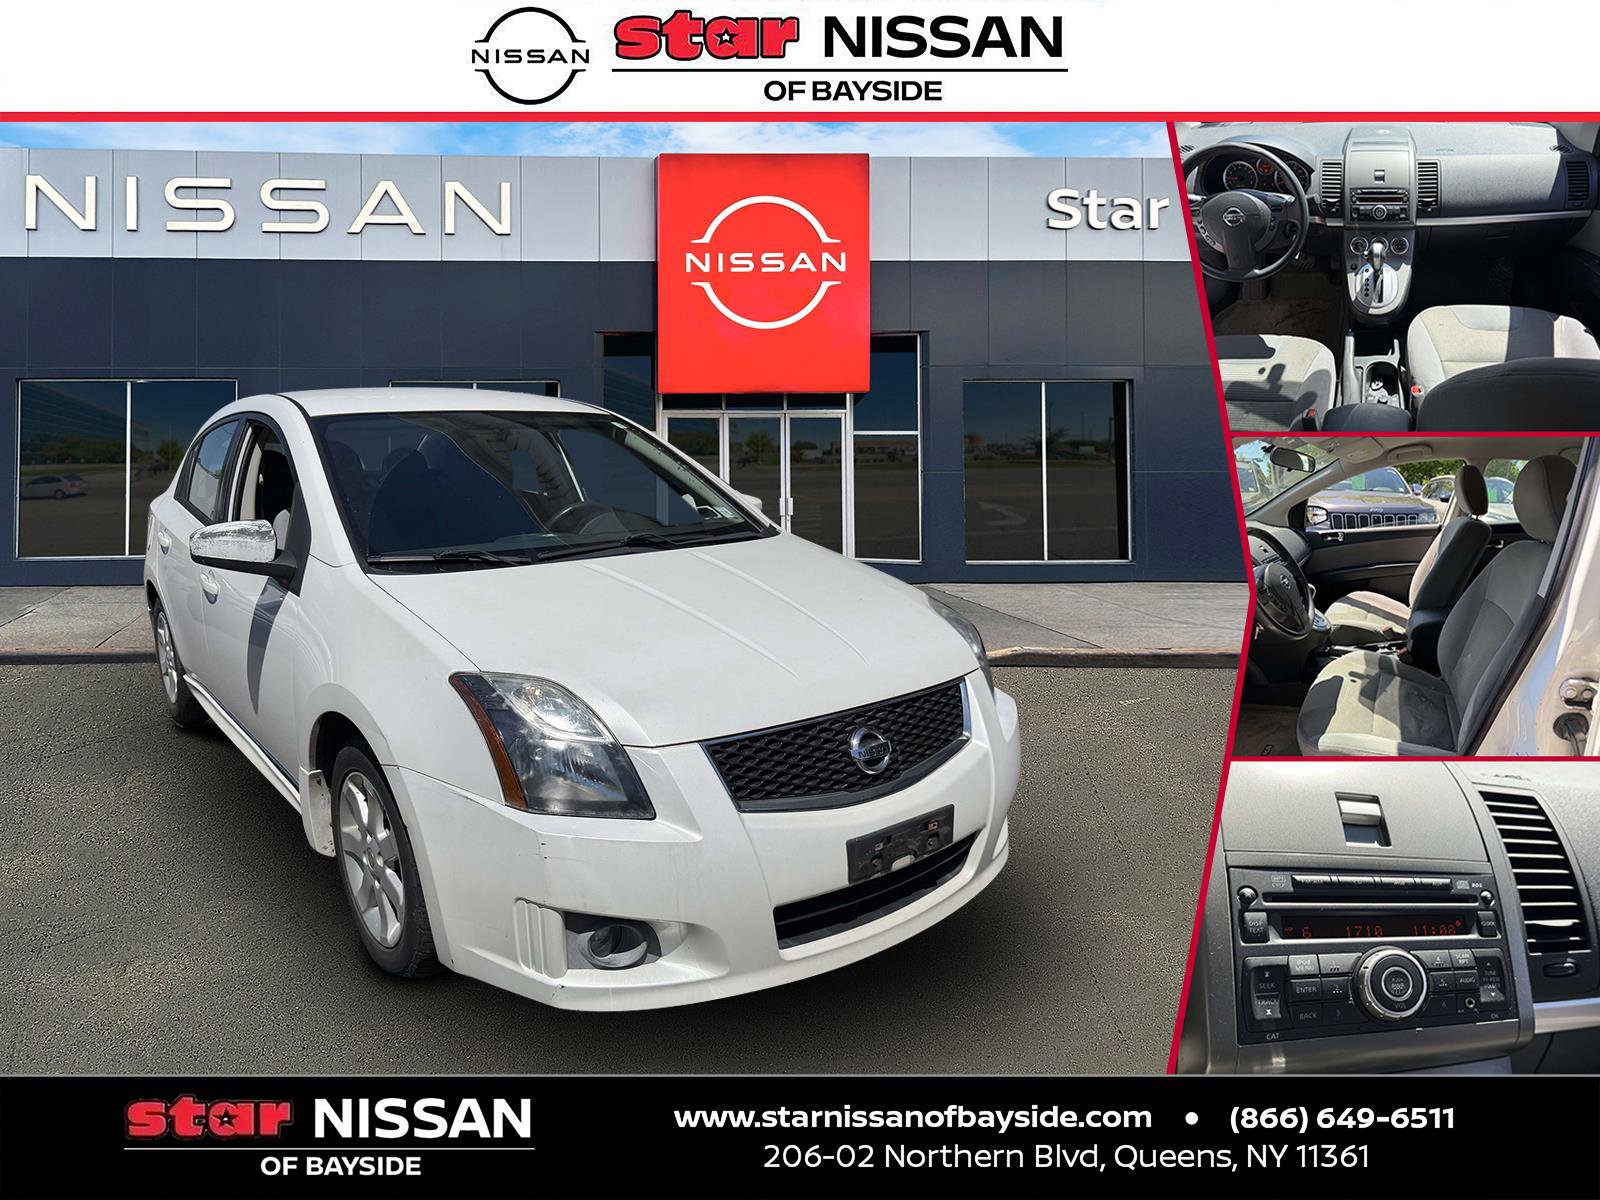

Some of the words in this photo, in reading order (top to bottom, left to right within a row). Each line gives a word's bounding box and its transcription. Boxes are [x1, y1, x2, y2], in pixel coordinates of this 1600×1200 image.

[23, 174, 513, 236] NISSAN
[1046, 188, 1170, 231] Star
[685, 252, 847, 273] NISSAN
[1296, 985, 1317, 993] ENTER
[1266, 1032, 1280, 1041] CAT
